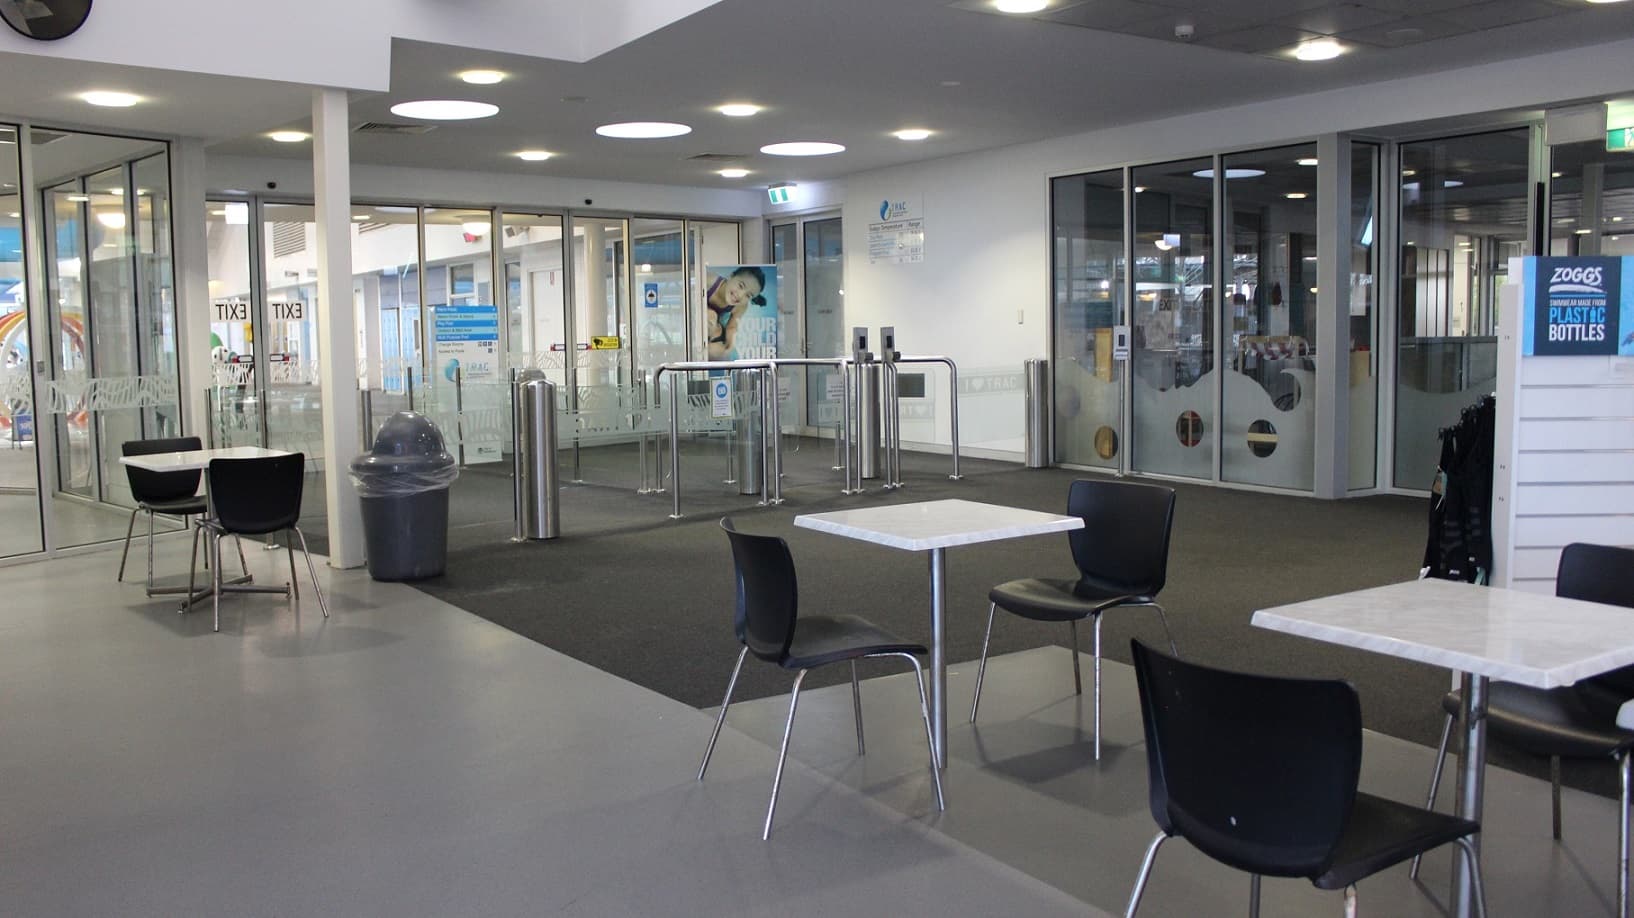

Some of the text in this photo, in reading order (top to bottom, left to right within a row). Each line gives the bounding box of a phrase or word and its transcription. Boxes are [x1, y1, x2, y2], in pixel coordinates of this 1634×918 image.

[1550, 266, 1603, 286] ZOGGS
[1549, 306, 1605, 323] PLASTIC
[736, 317, 777, 332] YOUR
[1549, 324, 1605, 341] BOTTLES
[736, 346, 777, 360] YOUR
[987, 376, 1017, 392] TRAC
